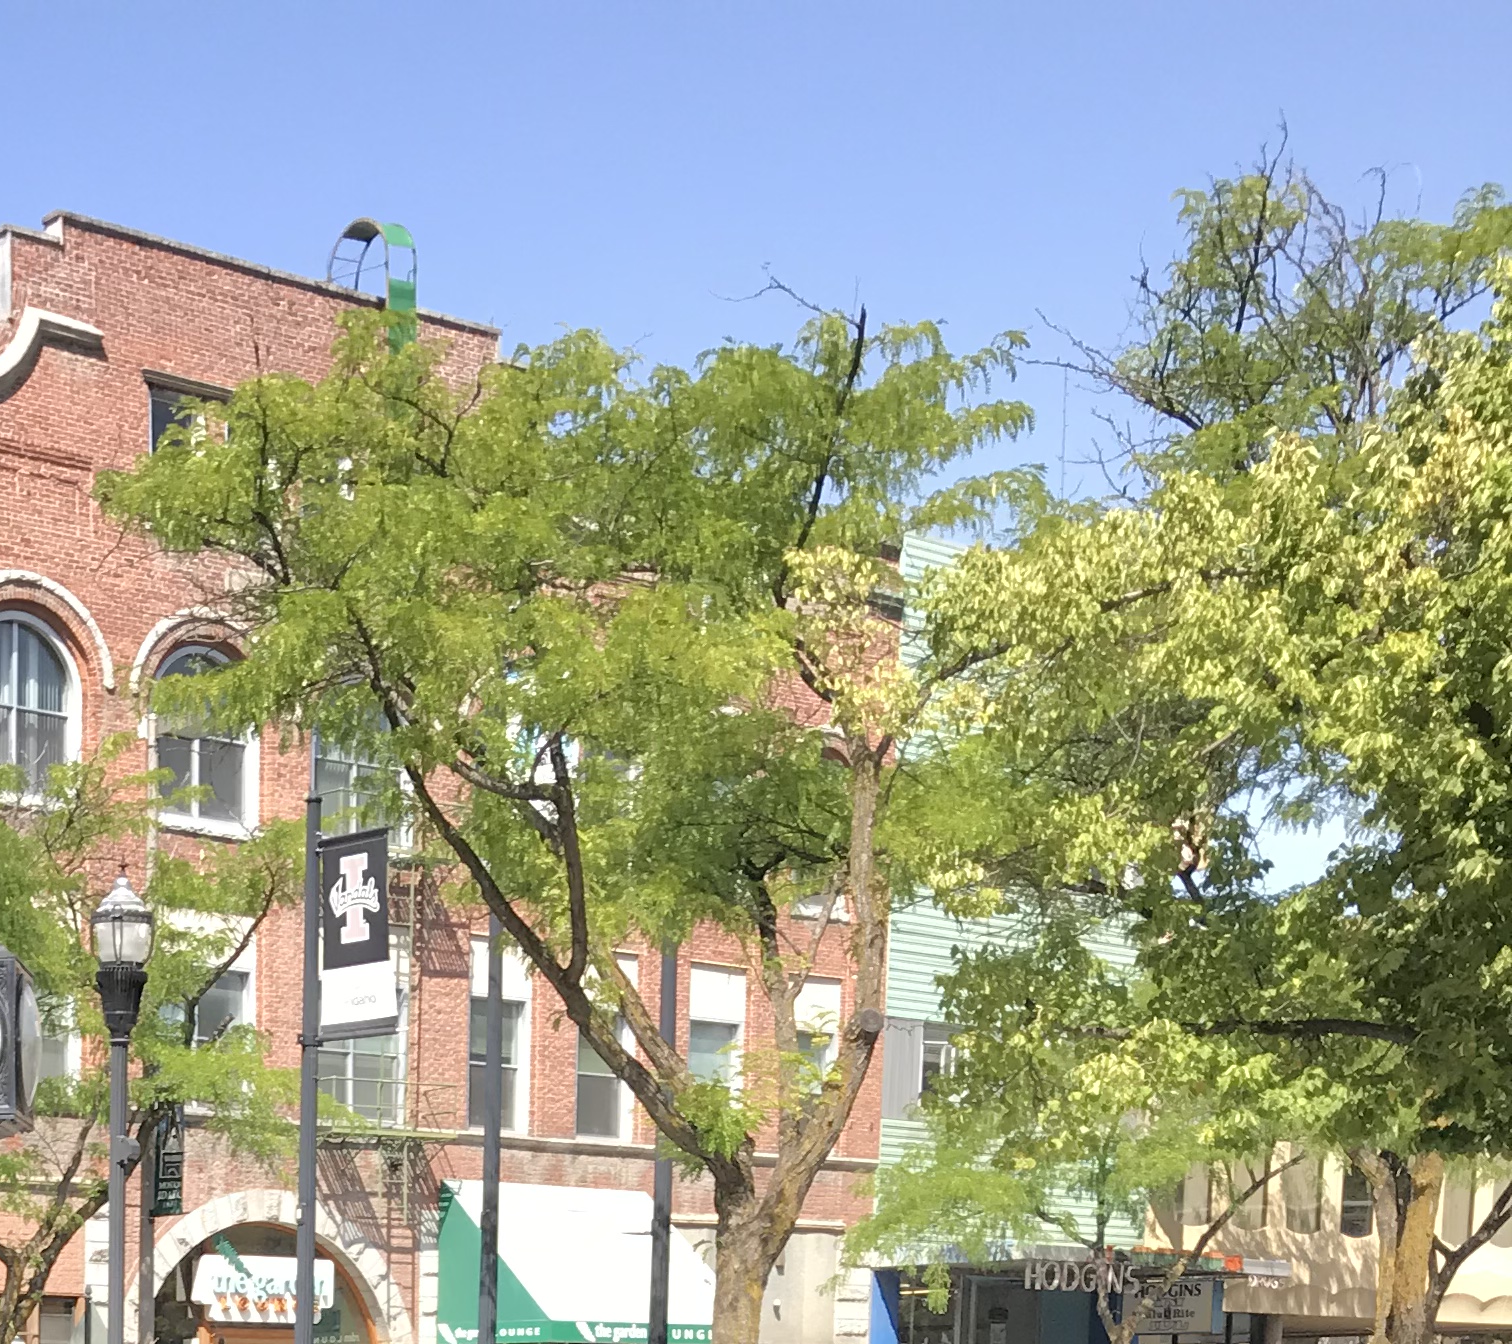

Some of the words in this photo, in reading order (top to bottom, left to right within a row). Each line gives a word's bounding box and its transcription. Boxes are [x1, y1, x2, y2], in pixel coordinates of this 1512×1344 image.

[329, 876, 380, 918] Vandals
[251, 1273, 325, 1301] garn
[1024, 1261, 1141, 1296] HODGNS
[1134, 1282, 1202, 1299] HOGINS
[218, 1295, 320, 1313] LOUNE
[1173, 1308, 1196, 1319] Rite
[495, 1327, 541, 1337] OUNGE
[595, 1323, 611, 1338] the
[613, 1323, 648, 1343] garden
[672, 1328, 713, 1340] UNG
